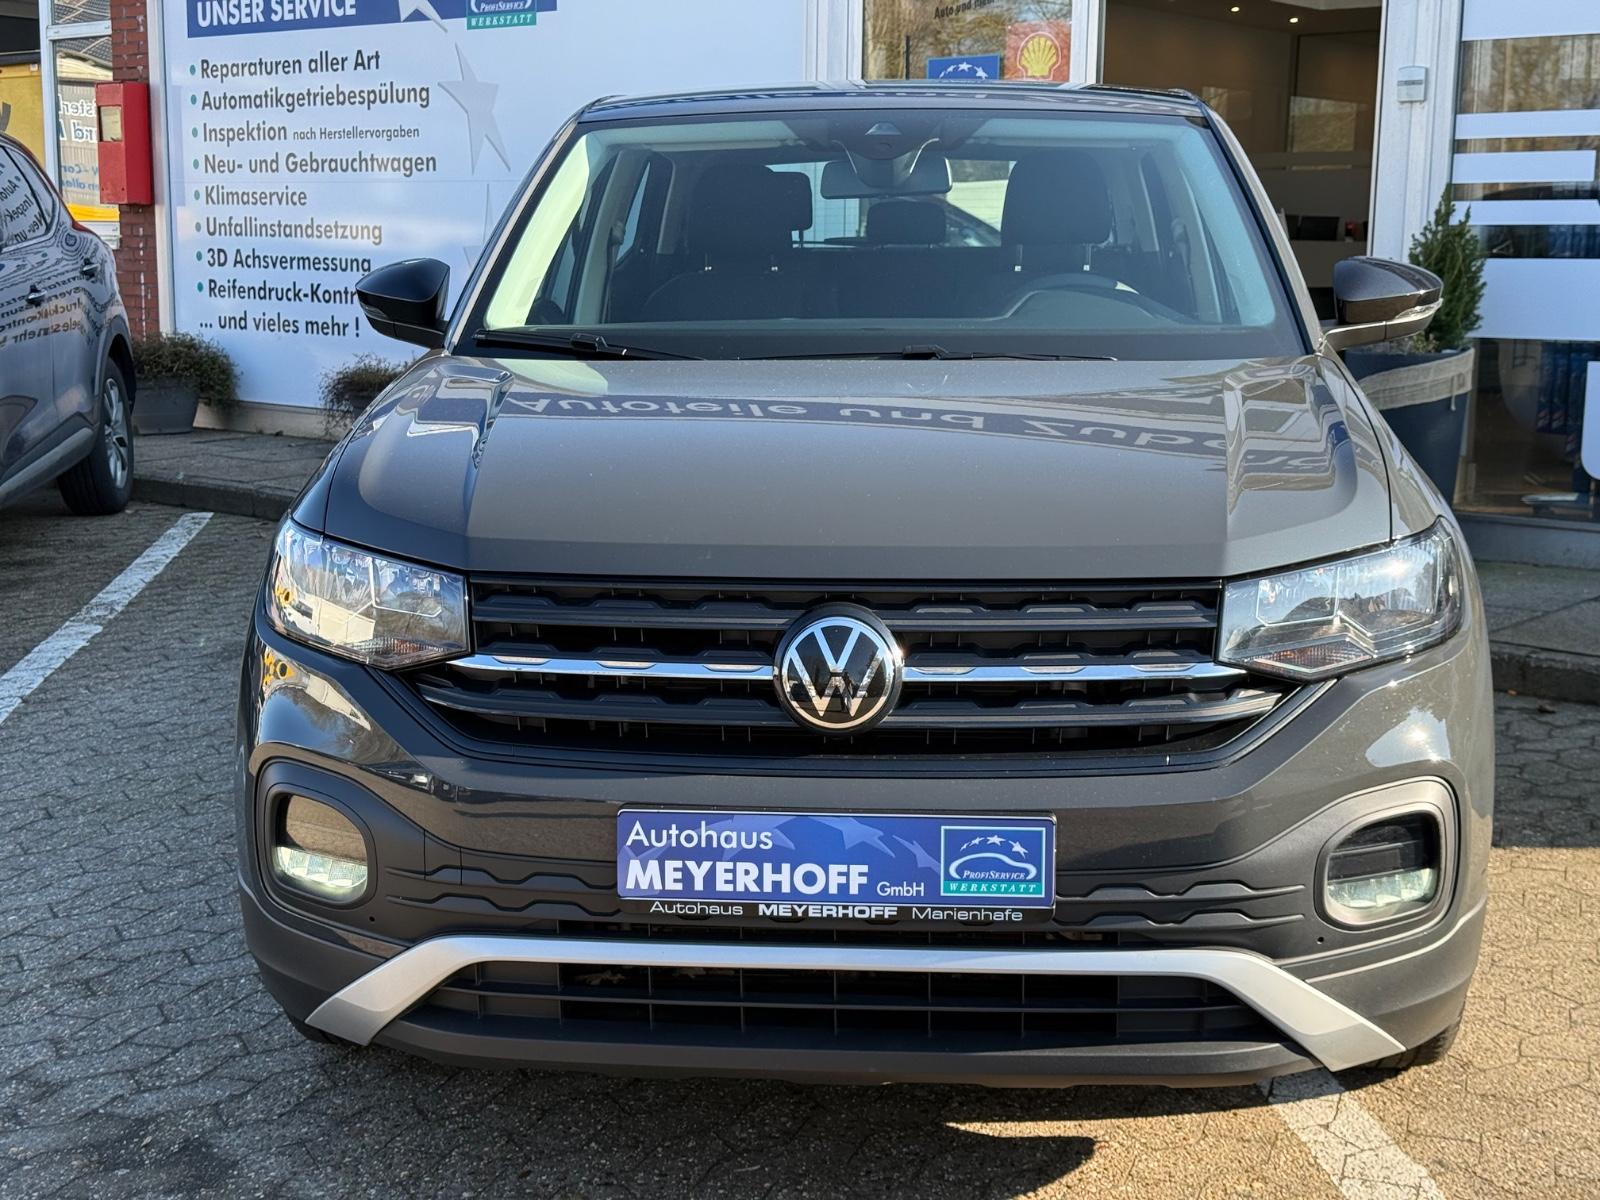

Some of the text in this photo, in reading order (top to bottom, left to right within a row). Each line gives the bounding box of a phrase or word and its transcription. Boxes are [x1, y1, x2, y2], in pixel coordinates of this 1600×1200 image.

[197, 0, 357, 27] UNSER SERVICE
[471, 14, 532, 26] WERKSTATT
[201, 49, 381, 83] Reparaturen aller Art
[201, 82, 431, 113] Automatikgetriebespülung
[203, 121, 420, 147] Inspektion nach Herstellervorgaben
[204, 151, 437, 177] Neu- und Gebrauchtwagen
[205, 186, 308, 207] Klimaservice
[206, 217, 383, 246] Unfallinstandsetzung
[207, 248, 371, 276] 3D Achsvermessung
[218, 311, 248, 332] und
[253, 313, 299, 335] vieles
[304, 316, 350, 337] mehr
[783, 617, 893, 728] VW
[626, 820, 773, 850] Autohaus
[625, 859, 924, 897] MEYERHOFF GmbH
[949, 882, 1038, 893] WERKSTATT
[650, 901, 1023, 922] Autohaus MEYERHOFF Marienhafe
